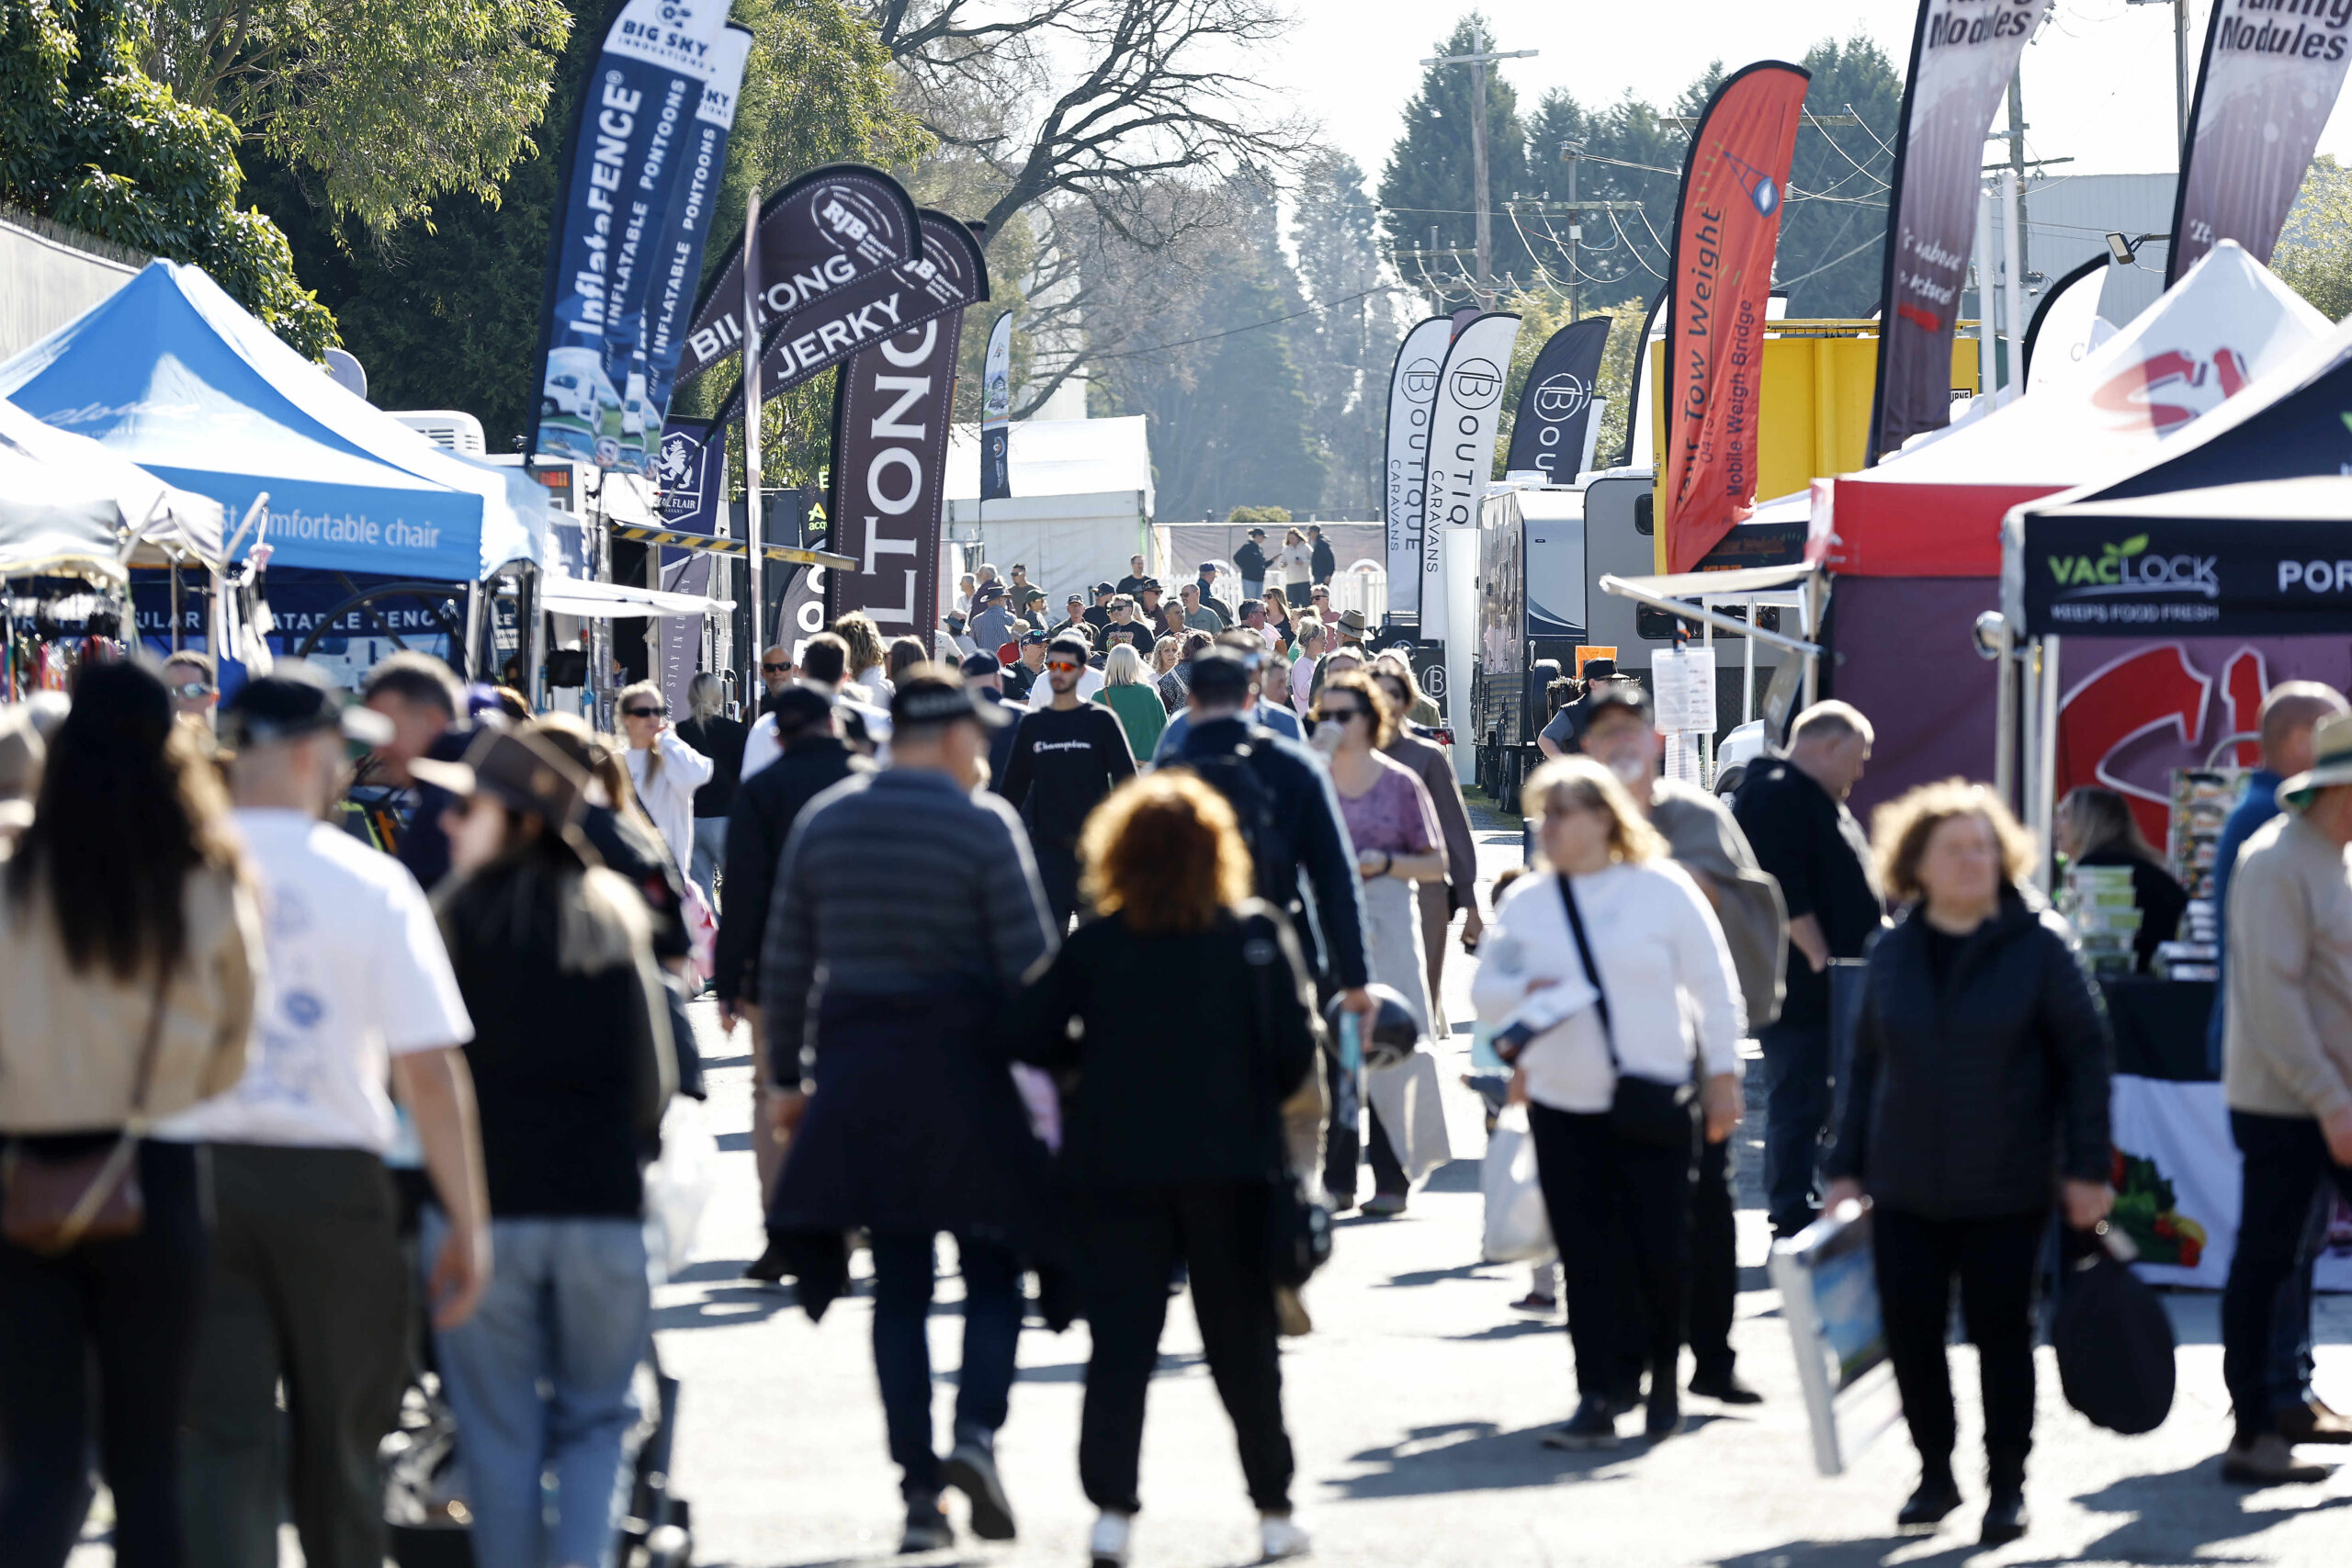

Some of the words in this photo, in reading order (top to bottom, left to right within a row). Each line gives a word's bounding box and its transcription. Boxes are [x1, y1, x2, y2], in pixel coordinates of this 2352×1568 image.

[623, 20, 659, 41] BIG
[665, 32, 708, 57] SKY
[607, 200, 649, 326] INFLATABLE
[639, 79, 686, 191] PONTOONS
[822, 198, 869, 242] RJB
[652, 241, 691, 355] INFLATABLE
[683, 128, 717, 231] PONTOONS
[903, 257, 937, 281] JB
[1689, 207, 1721, 337] Weight
[777, 292, 901, 380] JERKY
[1732, 299, 1755, 367] Bridge
[1684, 349, 1706, 422] Tow
[1727, 372, 1749, 434] Weigh
[1446, 358, 1502, 526] BOUTIQ
[1533, 373, 1584, 484] BOU
[862, 317, 938, 626] LTONG
[1726, 441, 1744, 497] Mobile
[247, 508, 379, 545] omfortable
[384, 516, 441, 548] chair
[673, 498, 695, 510] FLAIR
[1390, 459, 1401, 551] CARAVANS
[1426, 470, 1445, 573] CARAVANS
[2048, 554, 2219, 586] VACLOCK
[675, 578, 691, 629] LURY
[2110, 603, 2160, 624] FOOD
[666, 655, 681, 687] STAY
[673, 636, 684, 649] IN
[1033, 739, 1091, 753] Champion
